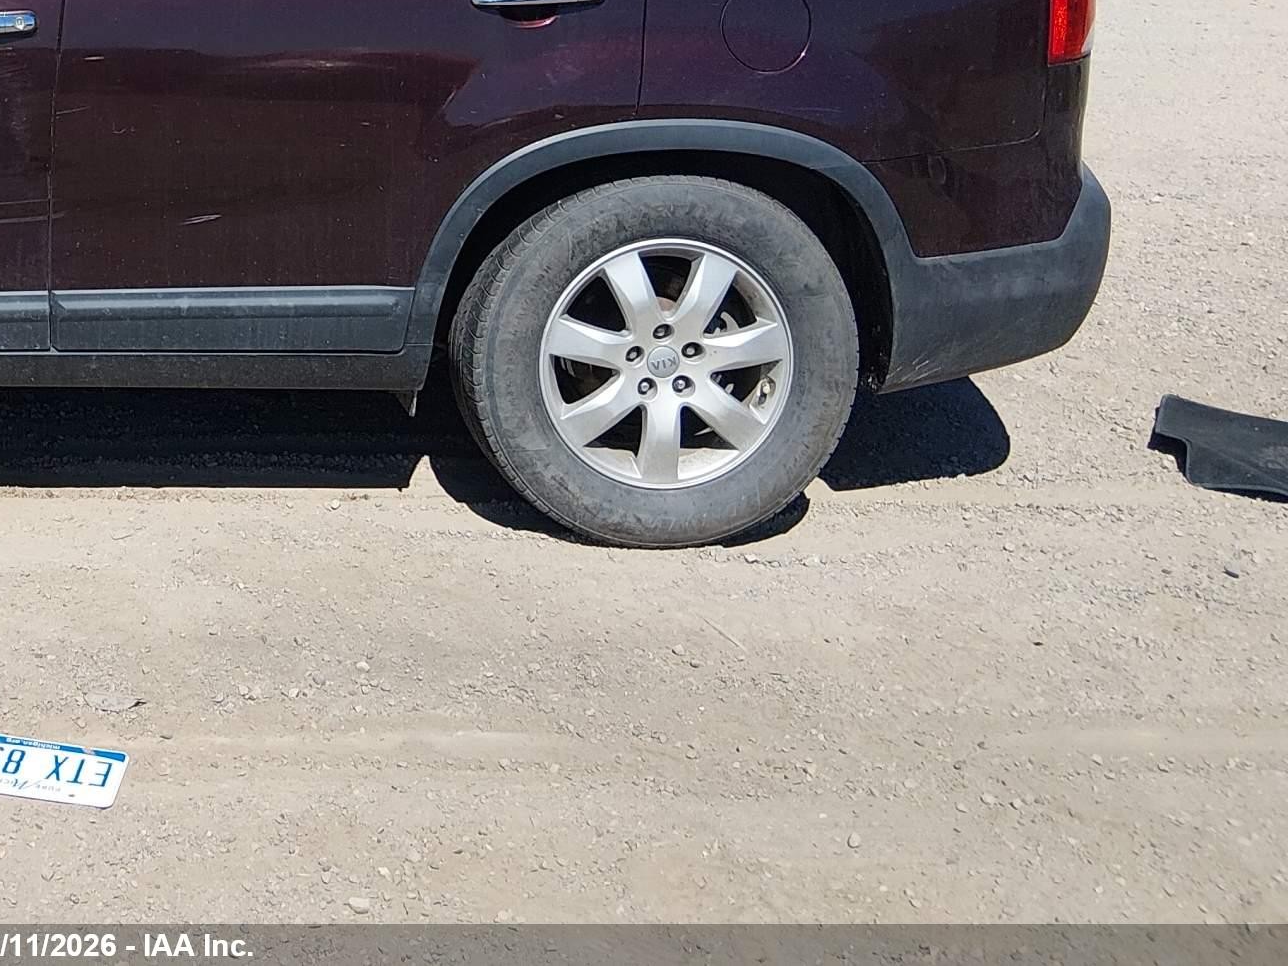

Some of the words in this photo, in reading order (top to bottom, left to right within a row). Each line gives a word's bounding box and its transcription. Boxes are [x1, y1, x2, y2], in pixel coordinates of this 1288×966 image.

[651, 356, 677, 371] KIA
[6, 736, 61, 750] michigan.org
[44, 754, 113, 788] ETX
